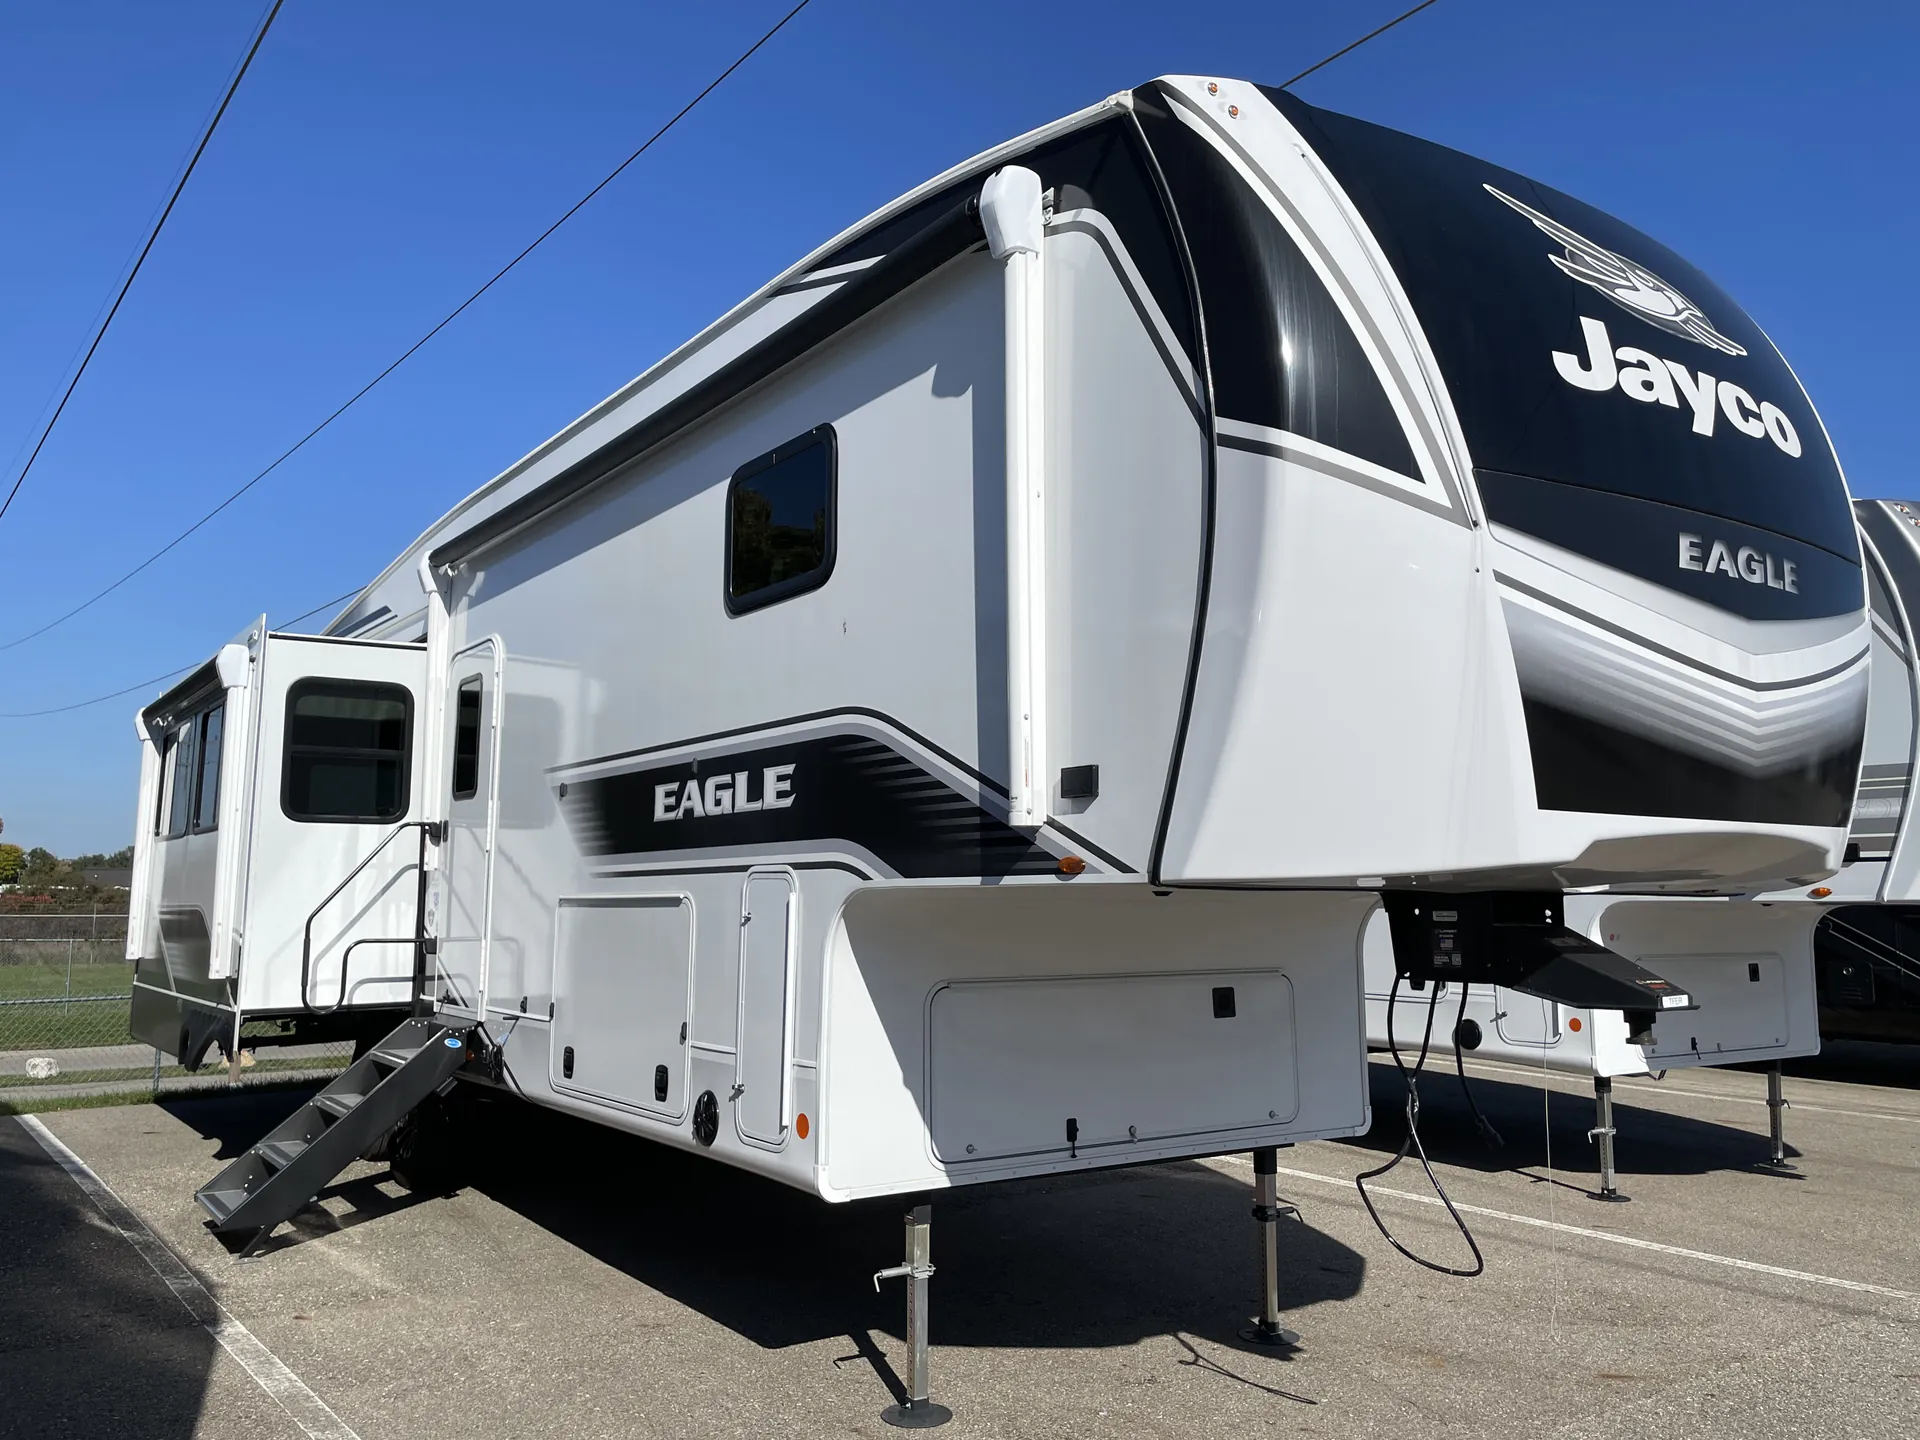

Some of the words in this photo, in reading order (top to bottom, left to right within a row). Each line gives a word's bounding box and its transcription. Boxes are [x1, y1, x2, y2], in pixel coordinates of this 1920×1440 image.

[1552, 316, 1802, 458] Jayco
[1679, 533, 1799, 594] EAGLE
[653, 763, 797, 822] EAGLE
